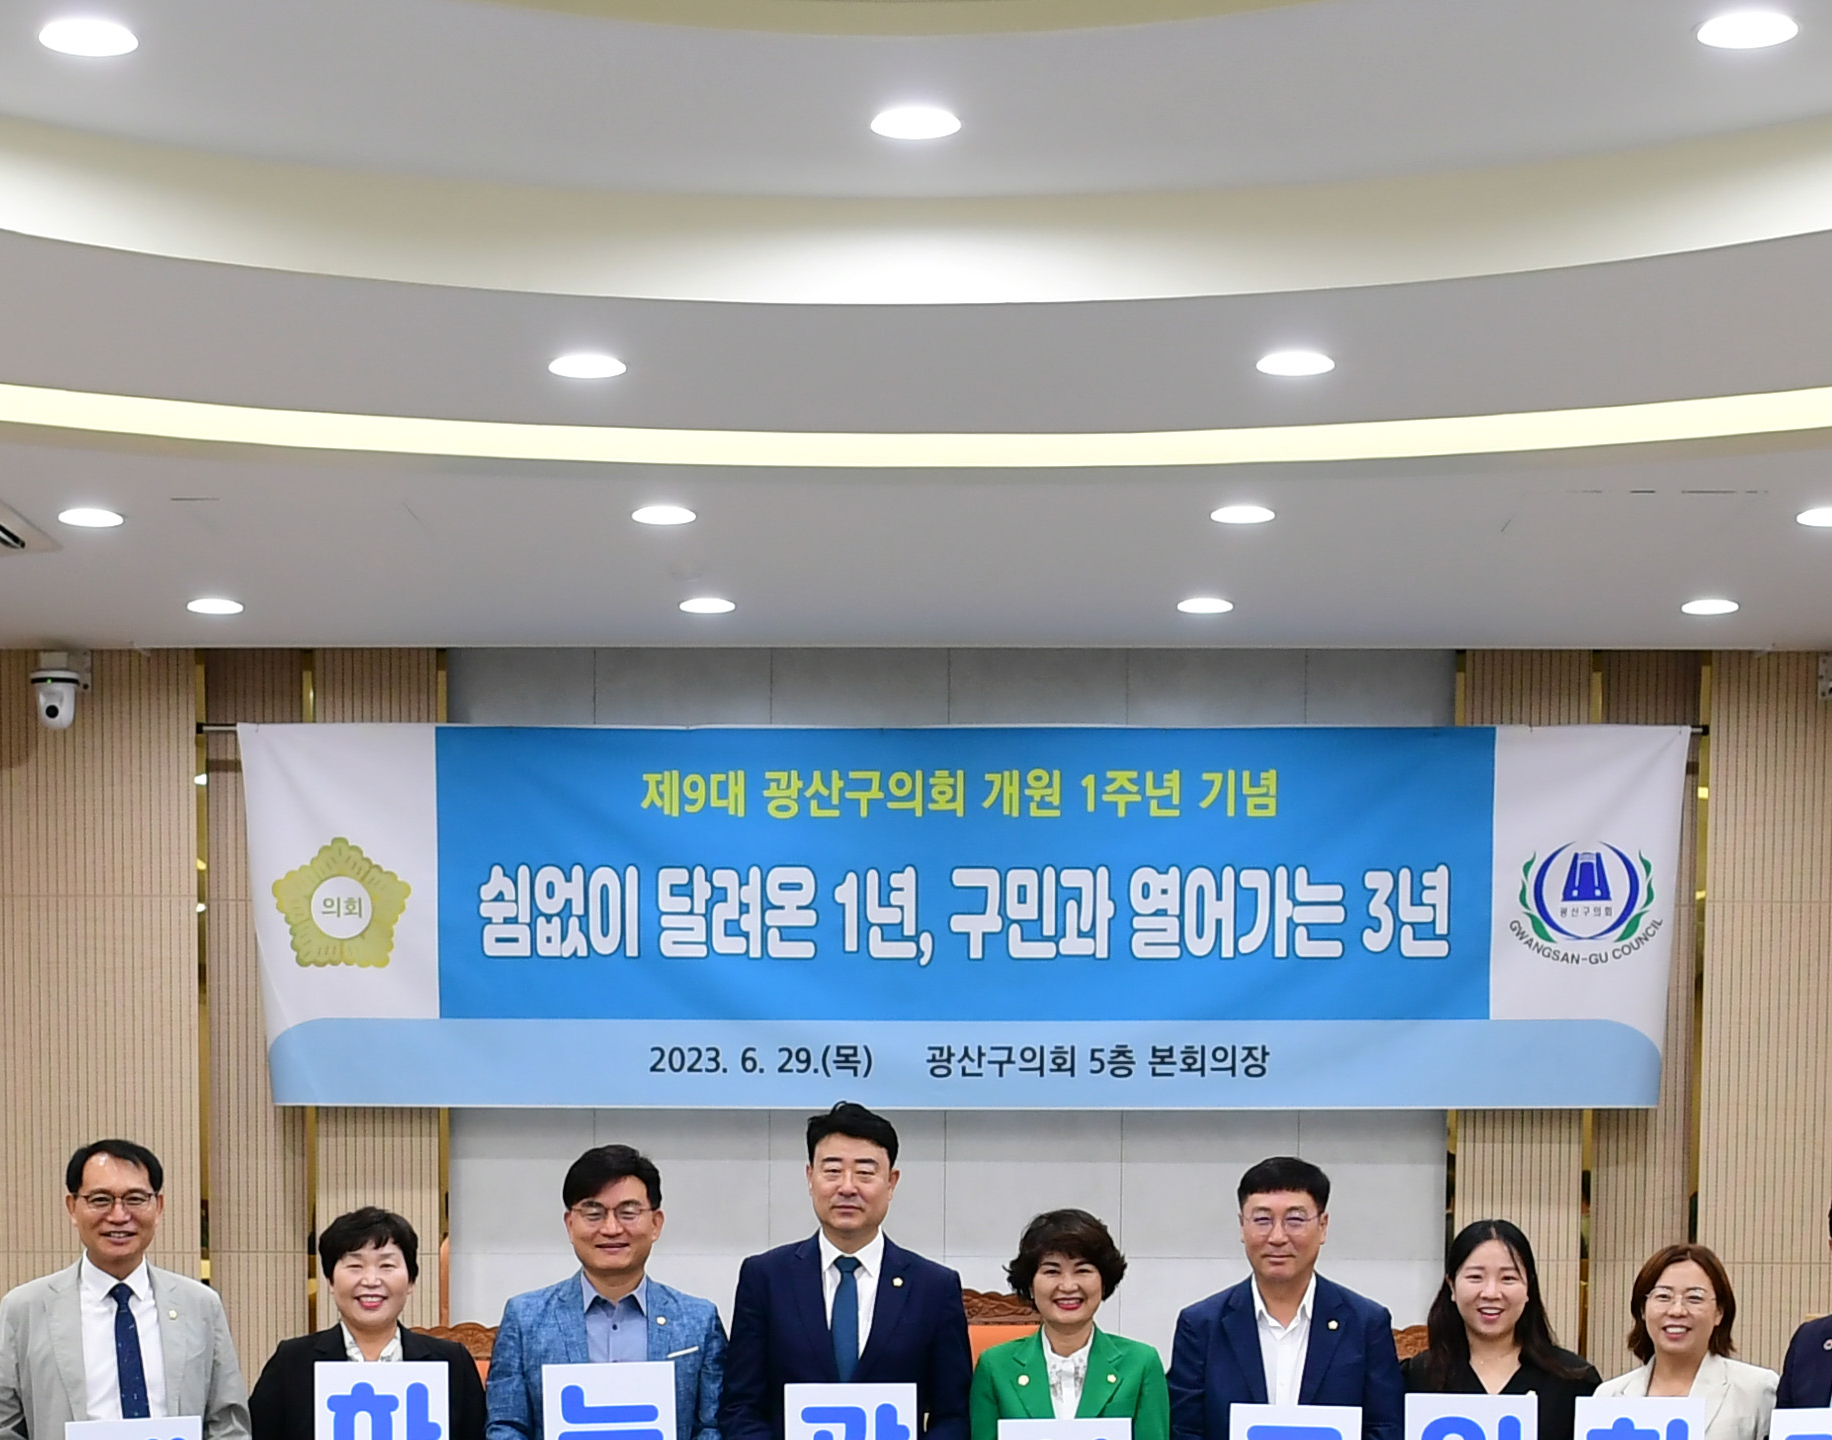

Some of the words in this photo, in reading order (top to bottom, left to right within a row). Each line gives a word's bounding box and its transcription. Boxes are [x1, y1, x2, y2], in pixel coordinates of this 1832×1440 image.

[642, 769, 746, 817] 제9대
[763, 769, 966, 818] 광산구의회
[983, 768, 1062, 818] 개원
[1080, 769, 1181, 818] 1주년
[1200, 768, 1279, 818] 기념
[321, 896, 363, 919] 의회
[478, 864, 640, 959] 쉼없이
[657, 865, 818, 959] 달려온
[833, 865, 933, 966] 1년,
[949, 865, 1115, 960] 구민과
[1129, 865, 1346, 959] 열어가는
[1362, 864, 1450, 958] 3년
[1559, 905, 1614, 919] 광산구의회
[1509, 919, 1609, 965] GWANGSAN-GU
[1612, 917, 1664, 961] COUNCIL
[649, 1045, 729, 1075] 2023.
[740, 1045, 766, 1075] 6.
[776, 1043, 874, 1079] 29.(목)
[925, 1043, 1077, 1079] 광산구의회
[1088, 1043, 1137, 1079] 5층
[1146, 1043, 1272, 1078] 본회의장
